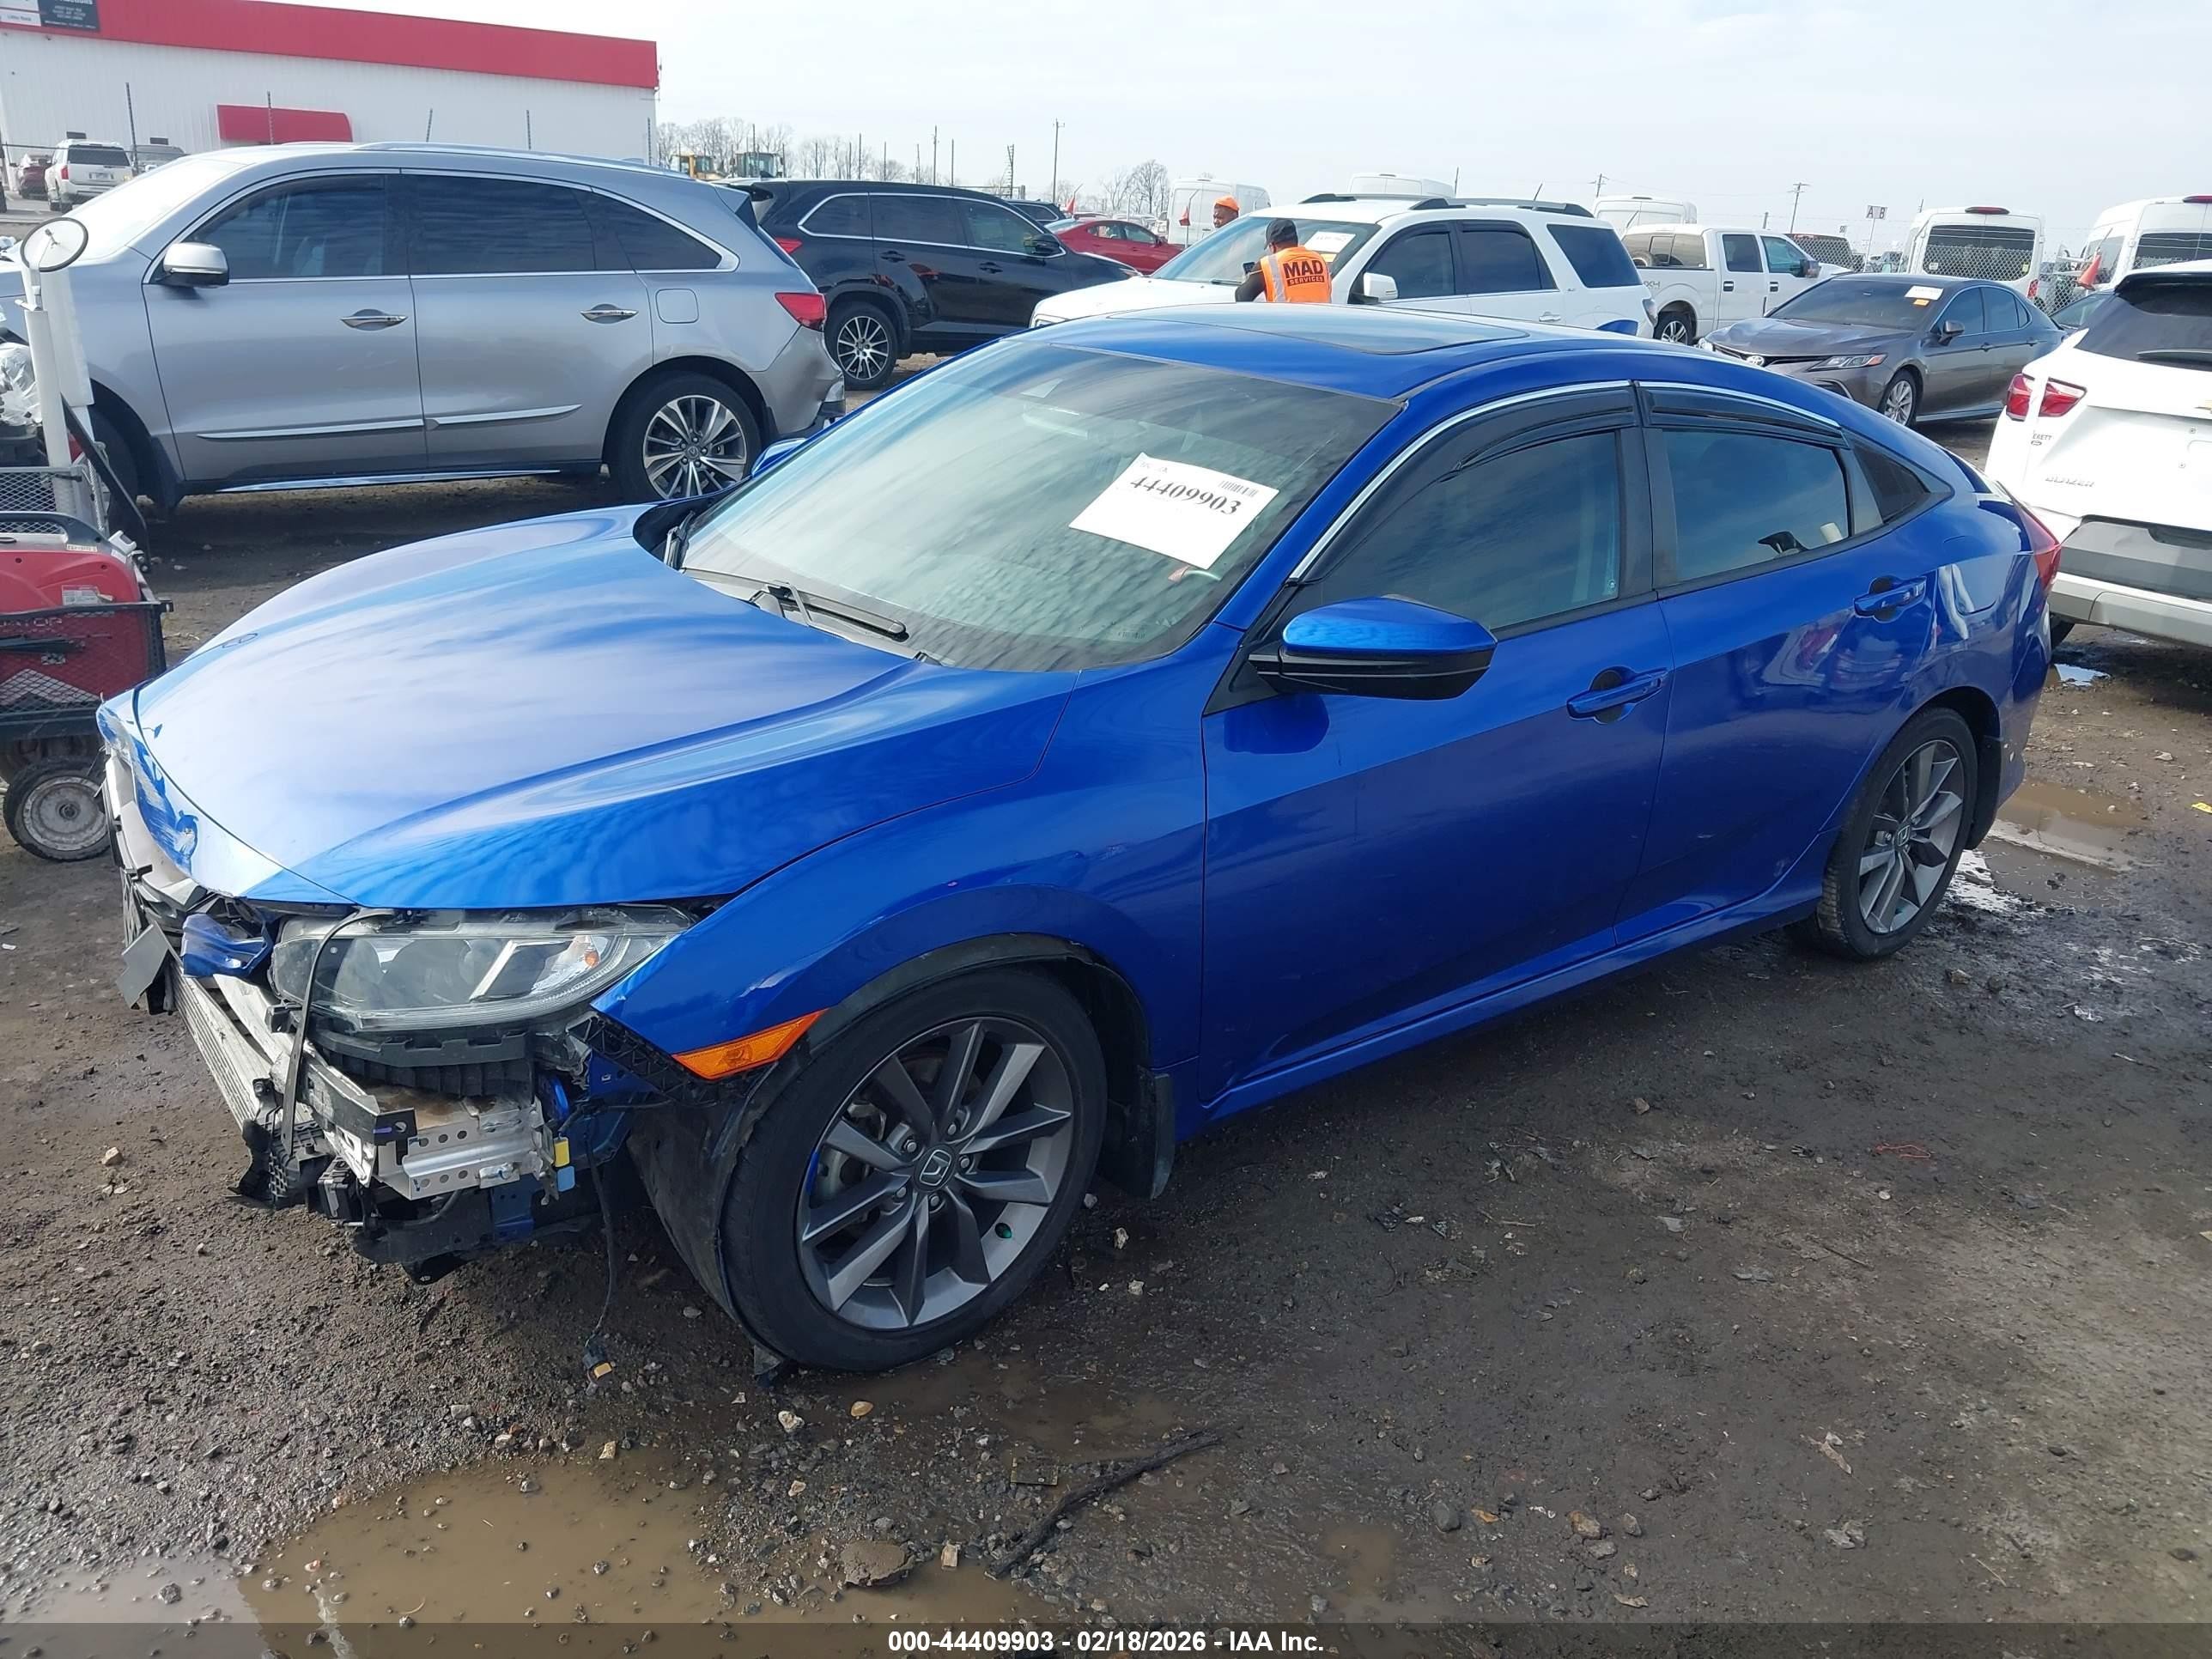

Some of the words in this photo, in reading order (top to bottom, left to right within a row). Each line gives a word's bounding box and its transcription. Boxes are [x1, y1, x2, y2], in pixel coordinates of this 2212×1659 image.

[1866, 206, 1873, 218] A
[1880, 207, 1886, 219] B
[1283, 260, 1323, 278] MAD
[1289, 276, 1324, 284] SERVICES
[1130, 477, 1242, 515] 44409903
